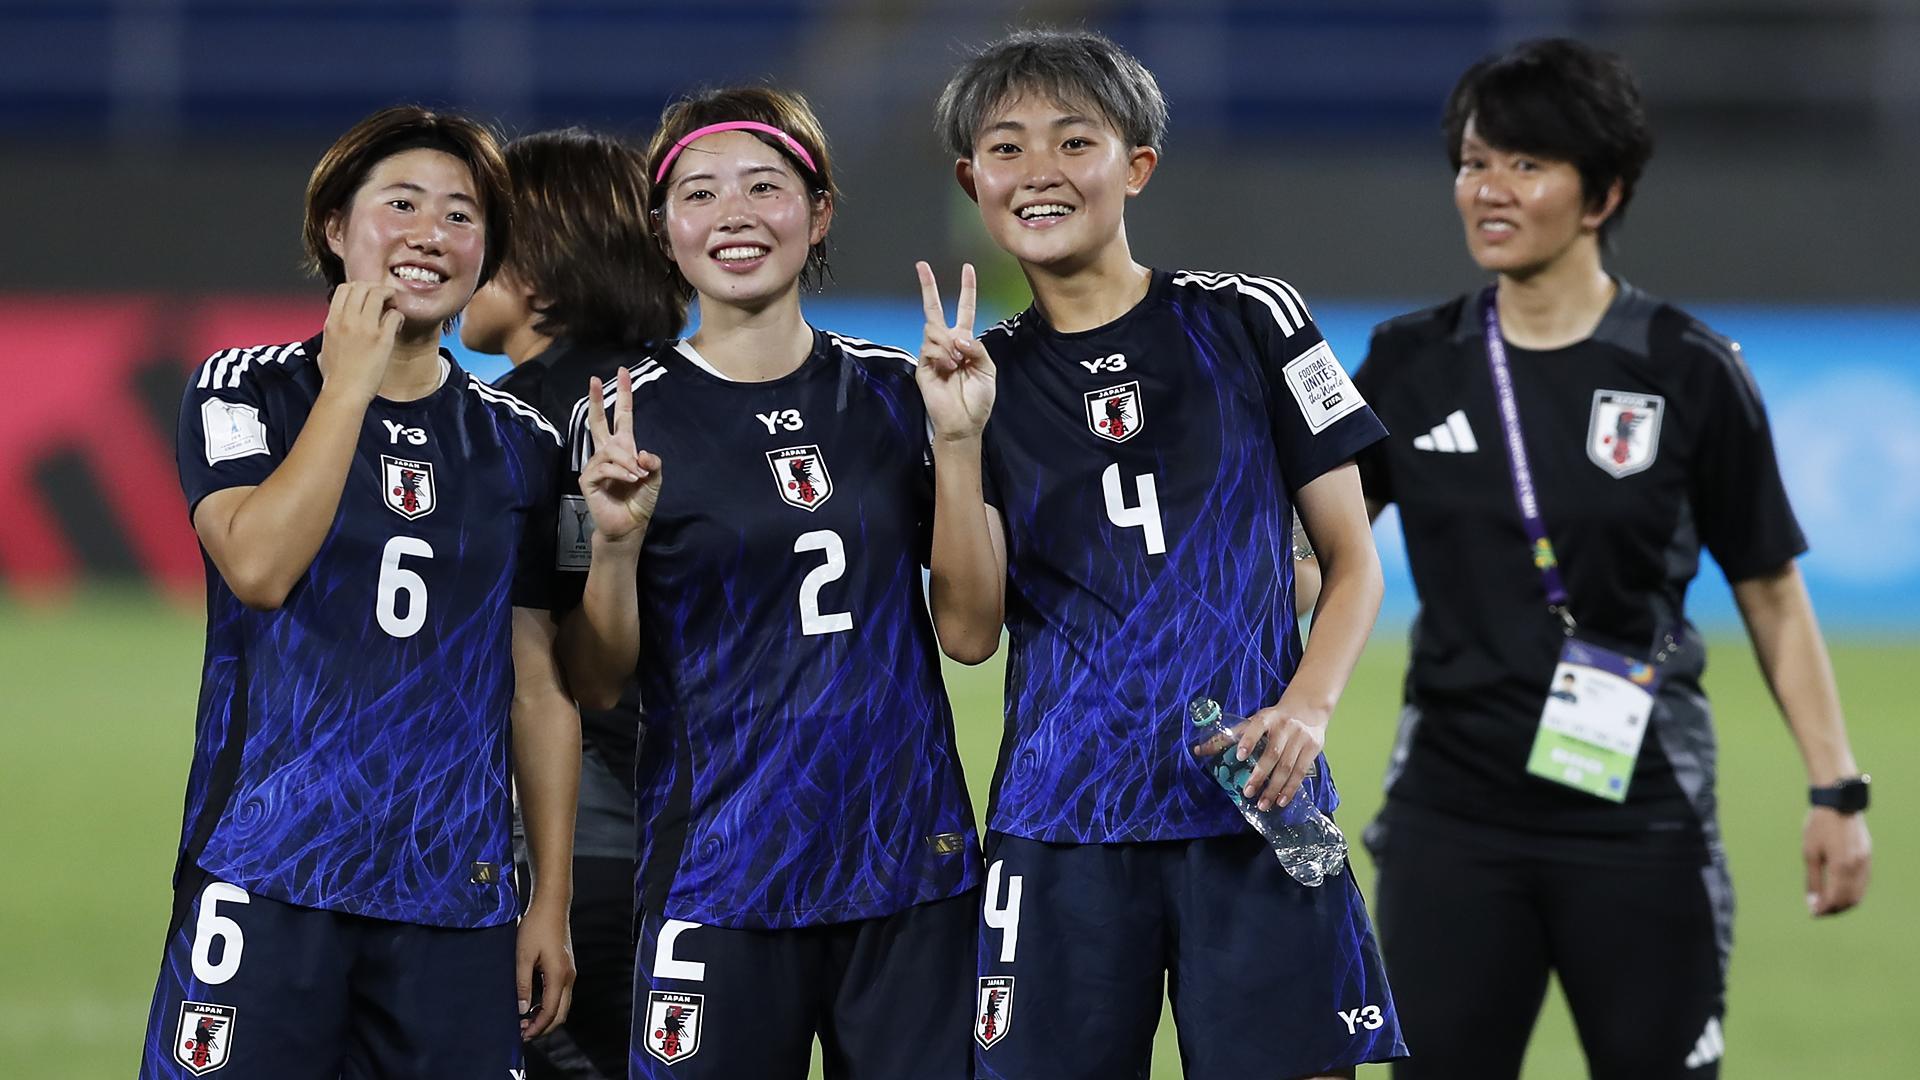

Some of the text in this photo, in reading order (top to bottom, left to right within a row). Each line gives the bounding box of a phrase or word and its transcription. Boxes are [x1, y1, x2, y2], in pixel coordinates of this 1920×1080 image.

[1080, 353, 1128, 374] Y-3
[1298, 355, 1332, 380] FOOTBALL
[1302, 364, 1337, 392] UNITES
[1098, 386, 1126, 398] JAPAN
[1308, 392, 1322, 405] the
[1324, 395, 1341, 408] FIFA
[382, 419, 428, 445] Y-3
[755, 410, 804, 435] Y-3
[394, 459, 420, 469] JAPAN
[781, 448, 807, 458] JAPAN
[1102, 463, 1167, 554] 4
[376, 536, 434, 638] 6
[793, 530, 853, 635] 2
[984, 858, 1022, 962] 4
[191, 881, 250, 985] 6
[194, 1005, 223, 1015] JAPAN
[662, 994, 691, 1003] JAPAN
[1337, 1005, 1384, 1035] Y-3
[187, 1051, 211, 1064] JFA
[658, 1041, 682, 1053] JFA
